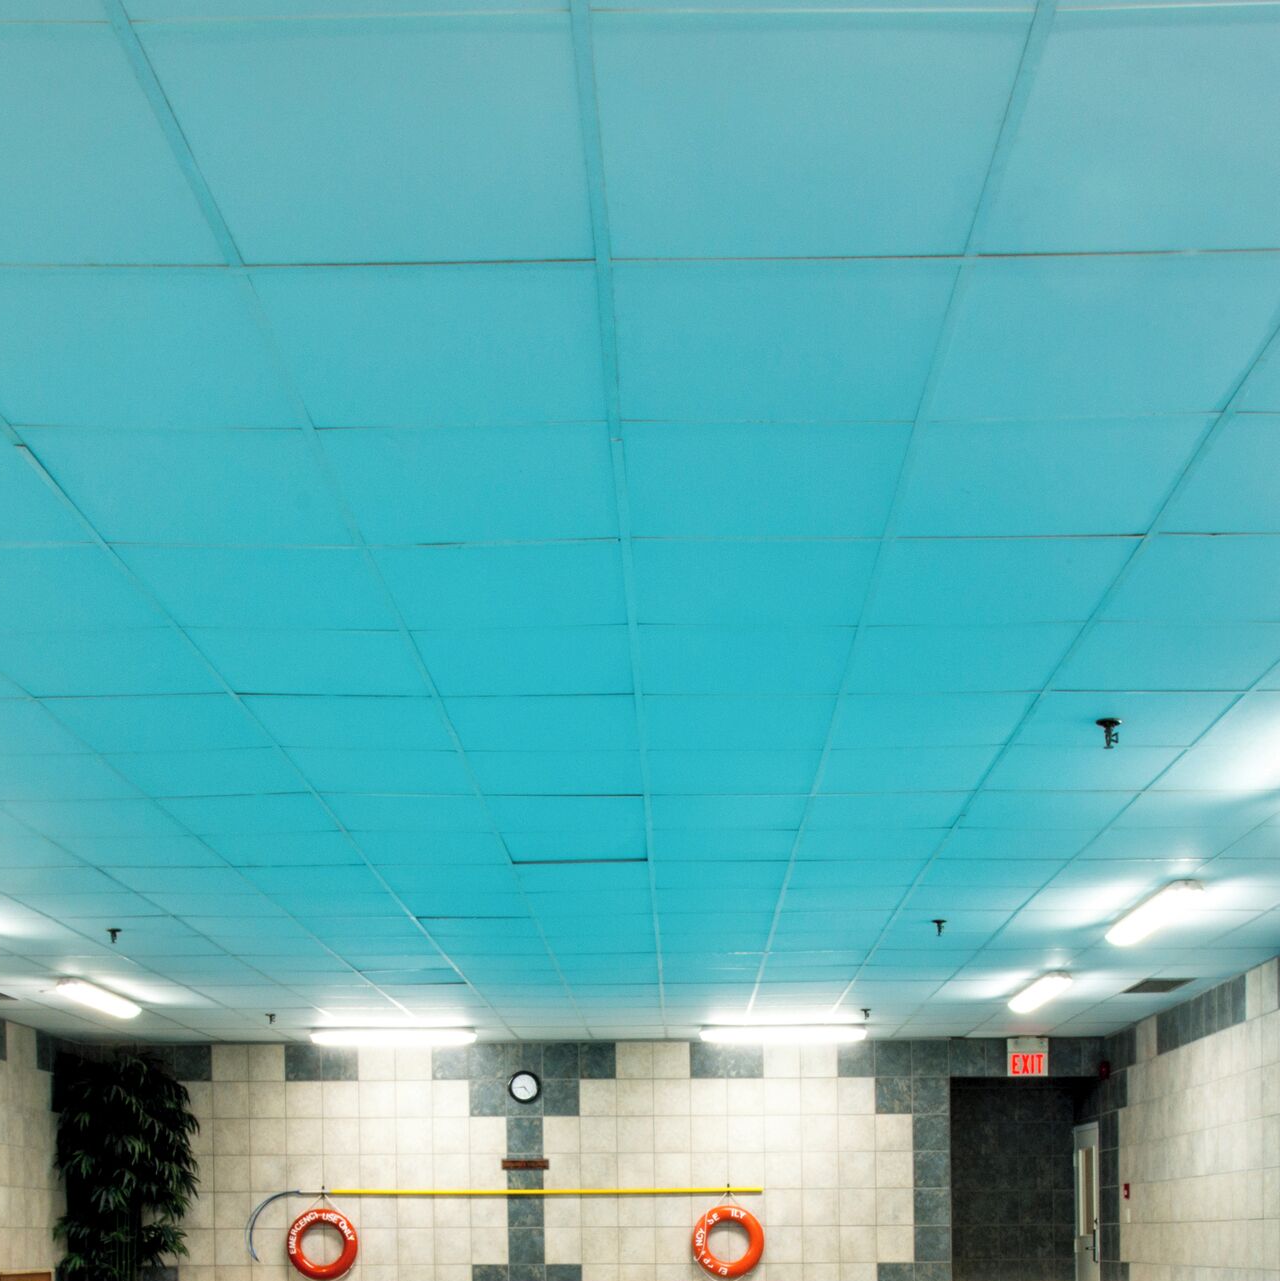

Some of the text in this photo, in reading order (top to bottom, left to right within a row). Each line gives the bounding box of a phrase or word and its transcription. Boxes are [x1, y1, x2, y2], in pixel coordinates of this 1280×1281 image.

[1012, 1054, 1044, 1075] EXIT
[322, 1213, 338, 1224] USE
[338, 1220, 355, 1241] ONLY
